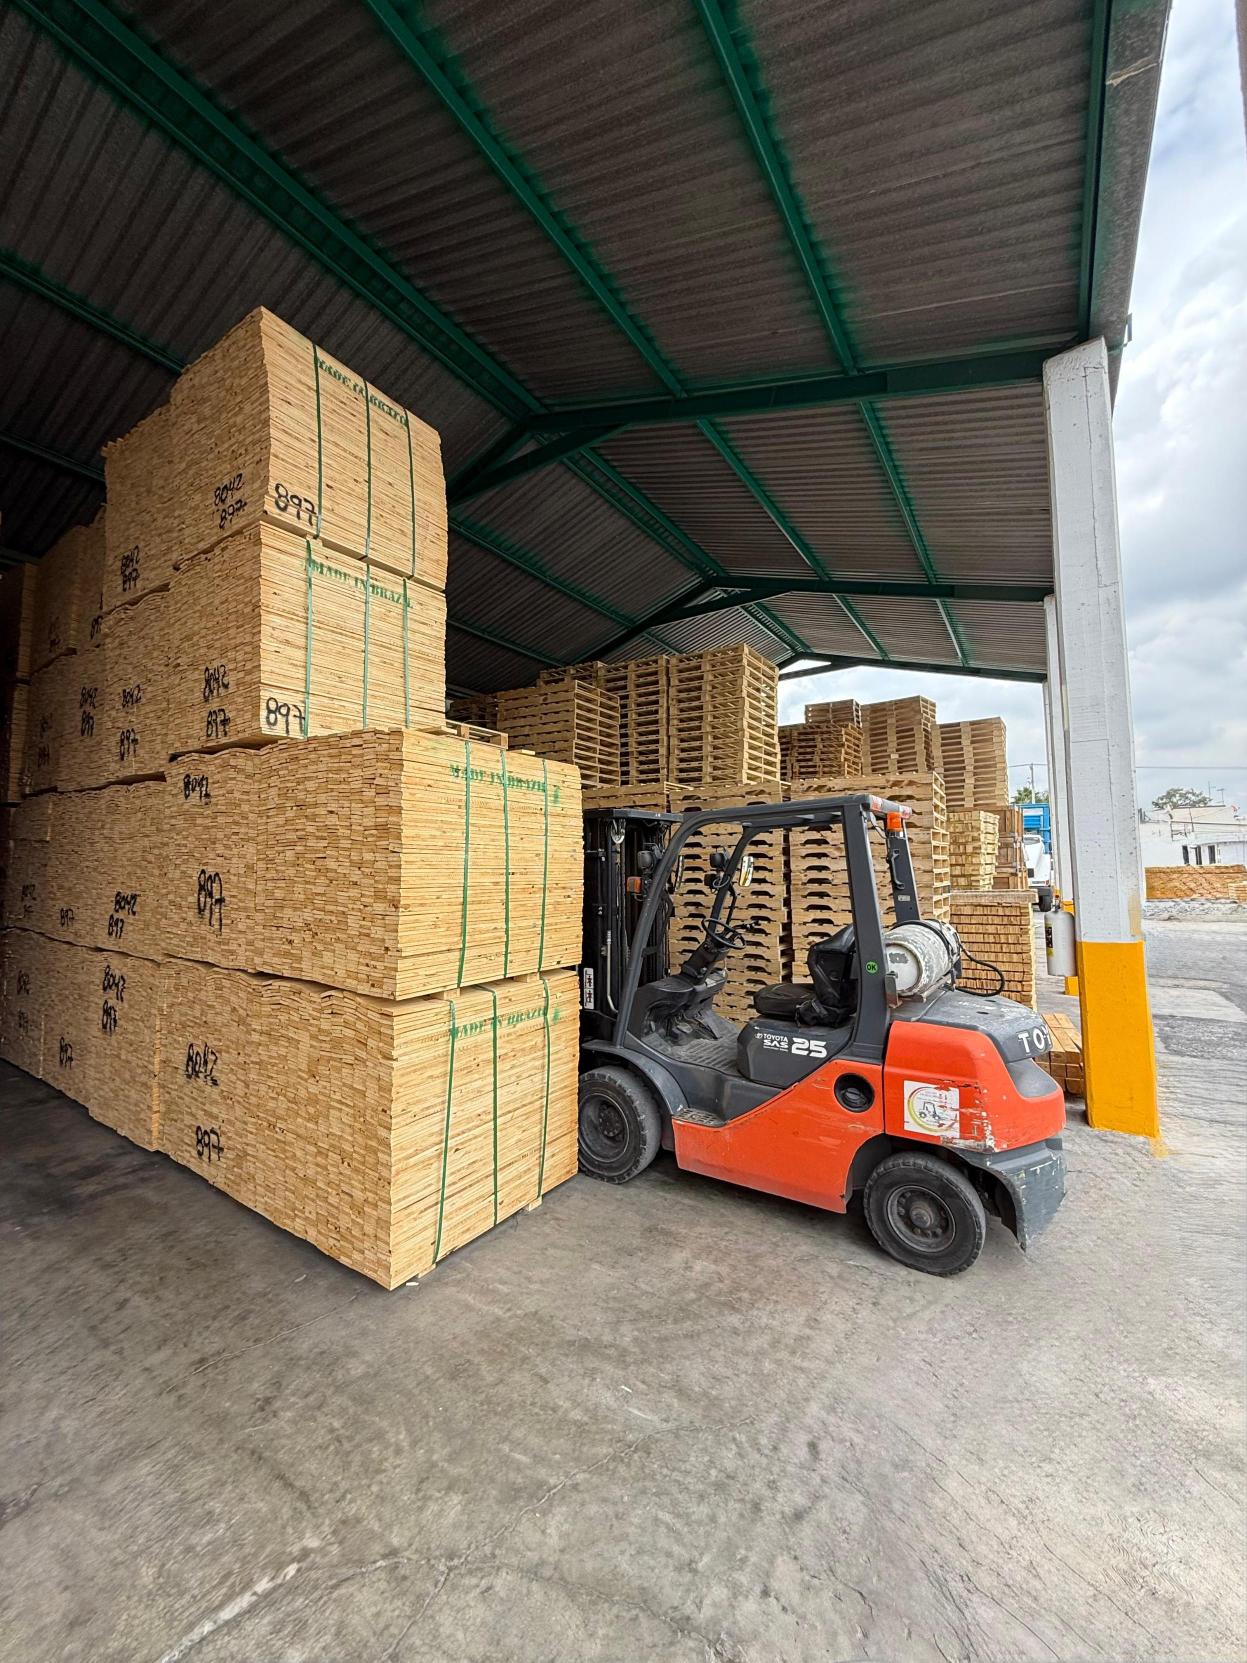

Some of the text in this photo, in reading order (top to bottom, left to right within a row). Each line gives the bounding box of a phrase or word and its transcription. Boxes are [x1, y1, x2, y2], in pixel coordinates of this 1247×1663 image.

[213, 473, 245, 506] 8042
[274, 483, 318, 526] 897
[219, 498, 248, 529] 897
[311, 559, 352, 582] MADE
[203, 664, 230, 702] 8042
[206, 708, 231, 738] 897
[266, 697, 306, 735] 897
[119, 728, 139, 761] 897
[183, 774, 210, 804] 8042
[113, 891, 139, 916] 8042
[197, 868, 225, 936] 897
[107, 913, 125, 939] 897
[866, 963, 877, 971] OK
[763, 1033, 789, 1043] TOYOTA
[763, 1040, 789, 1049] SAS
[791, 1037, 828, 1058] 25
[196, 1125, 224, 1163] 897
